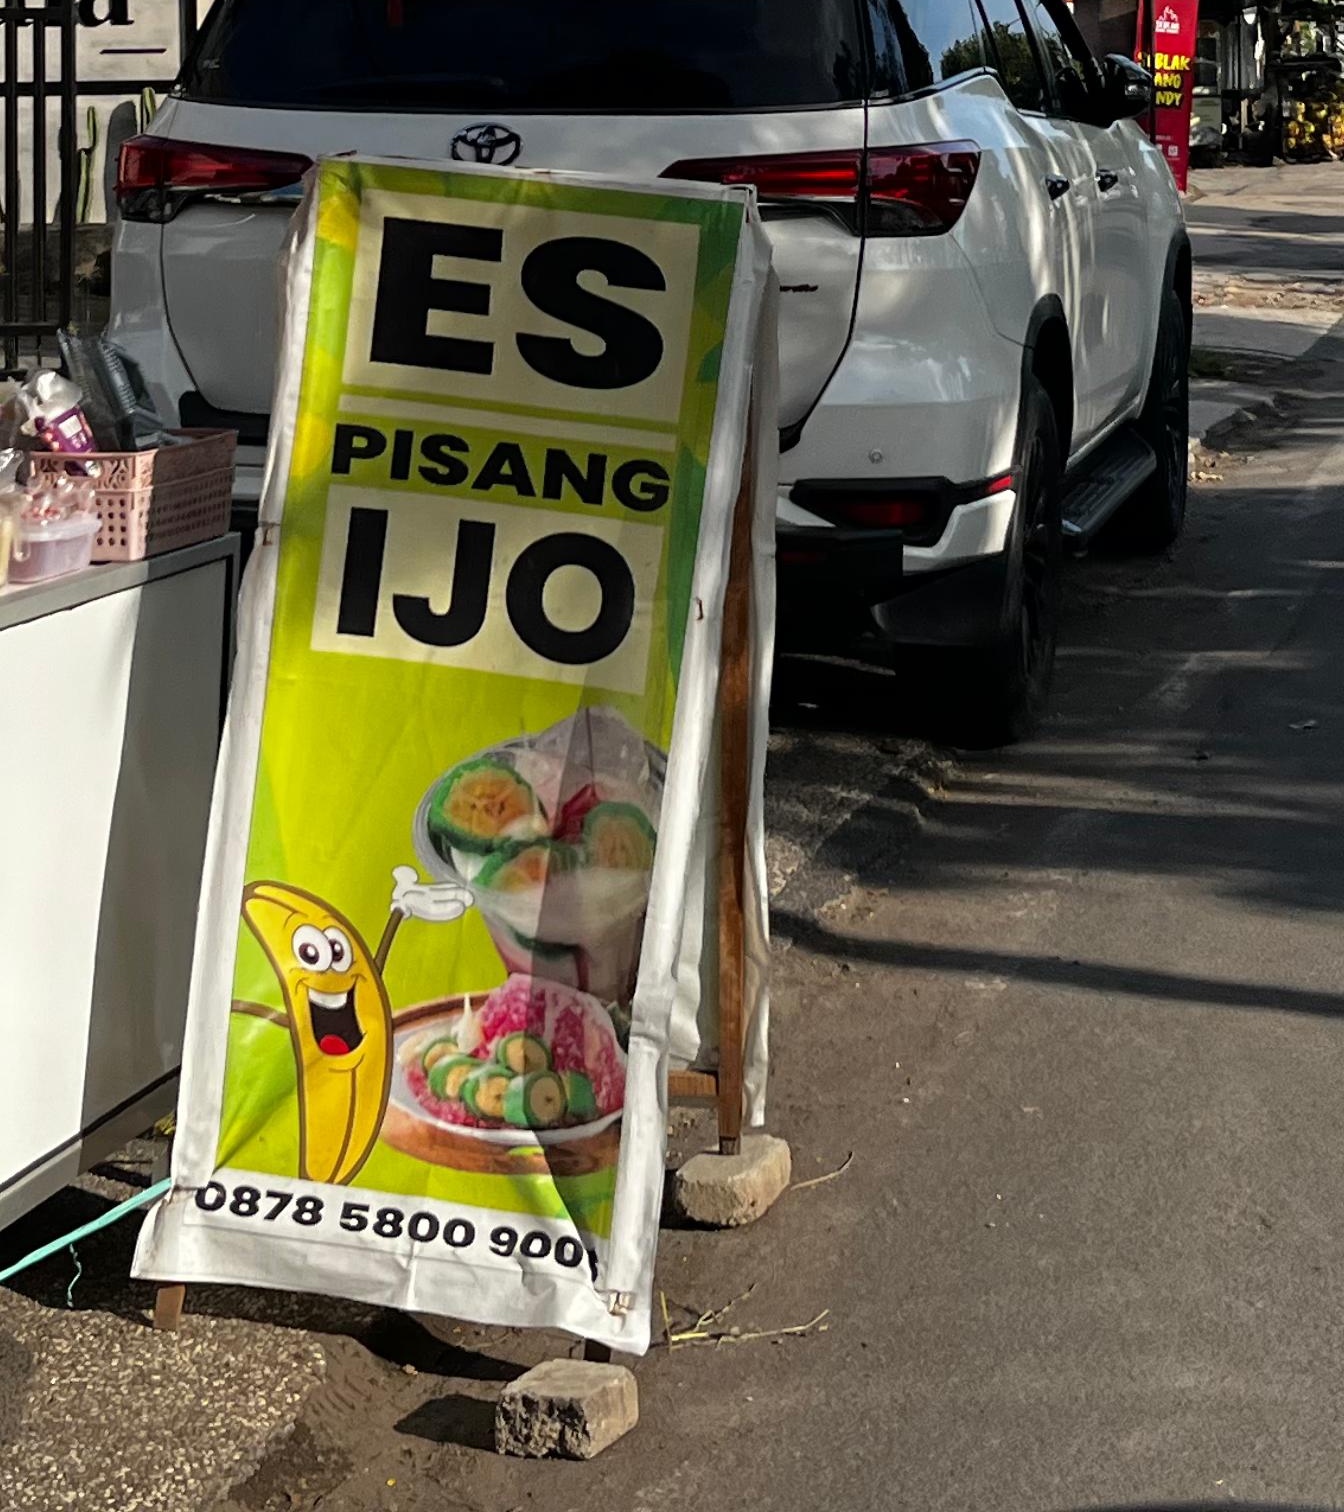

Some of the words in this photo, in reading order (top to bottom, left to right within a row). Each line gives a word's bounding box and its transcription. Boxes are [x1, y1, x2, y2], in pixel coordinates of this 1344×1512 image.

[369, 216, 667, 390] ES
[331, 423, 671, 512] PISANG
[336, 507, 636, 665] IJO
[194, 1181, 324, 1226] 0878
[339, 1201, 475, 1249] 5800
